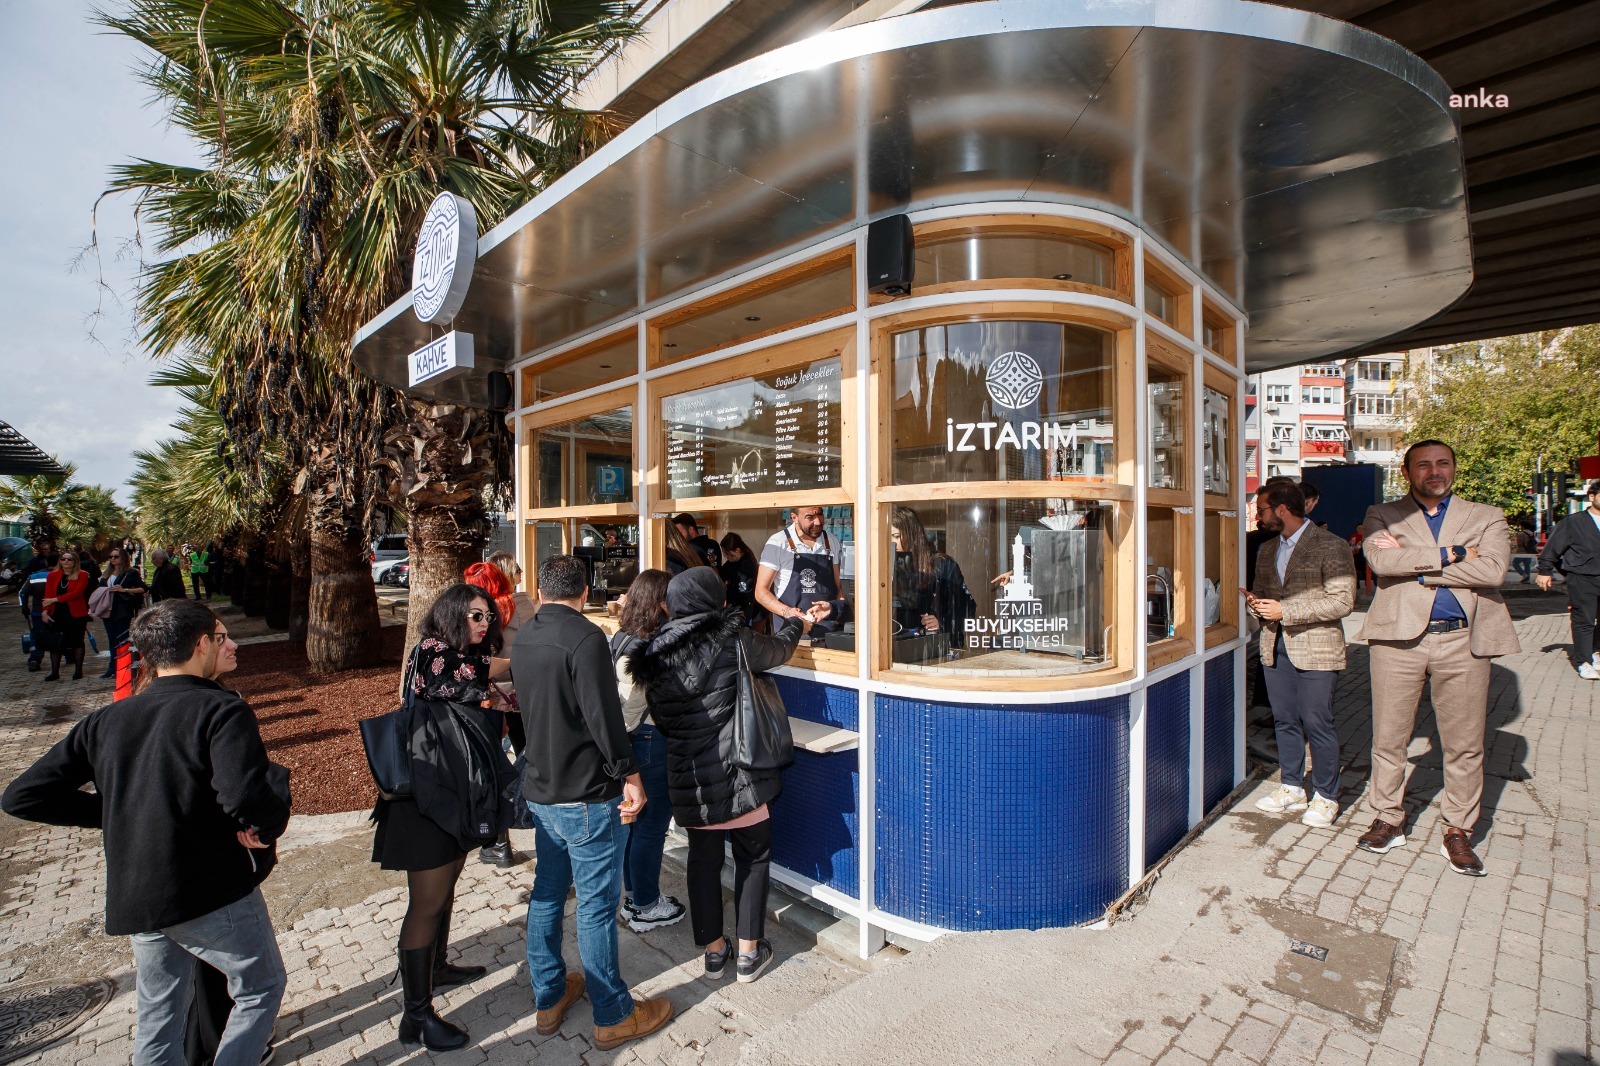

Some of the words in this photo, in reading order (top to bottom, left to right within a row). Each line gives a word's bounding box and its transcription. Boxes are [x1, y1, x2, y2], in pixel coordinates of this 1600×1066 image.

[416, 341, 447, 374] KAHVE
[775, 374, 798, 388] Soğuk
[798, 366, 834, 384] İçecekler
[947, 418, 1078, 452] İZTARIM
[602, 469, 616, 492] P
[994, 602, 1043, 616] İZMİR
[969, 633, 1065, 648] BELEDİYESİ
